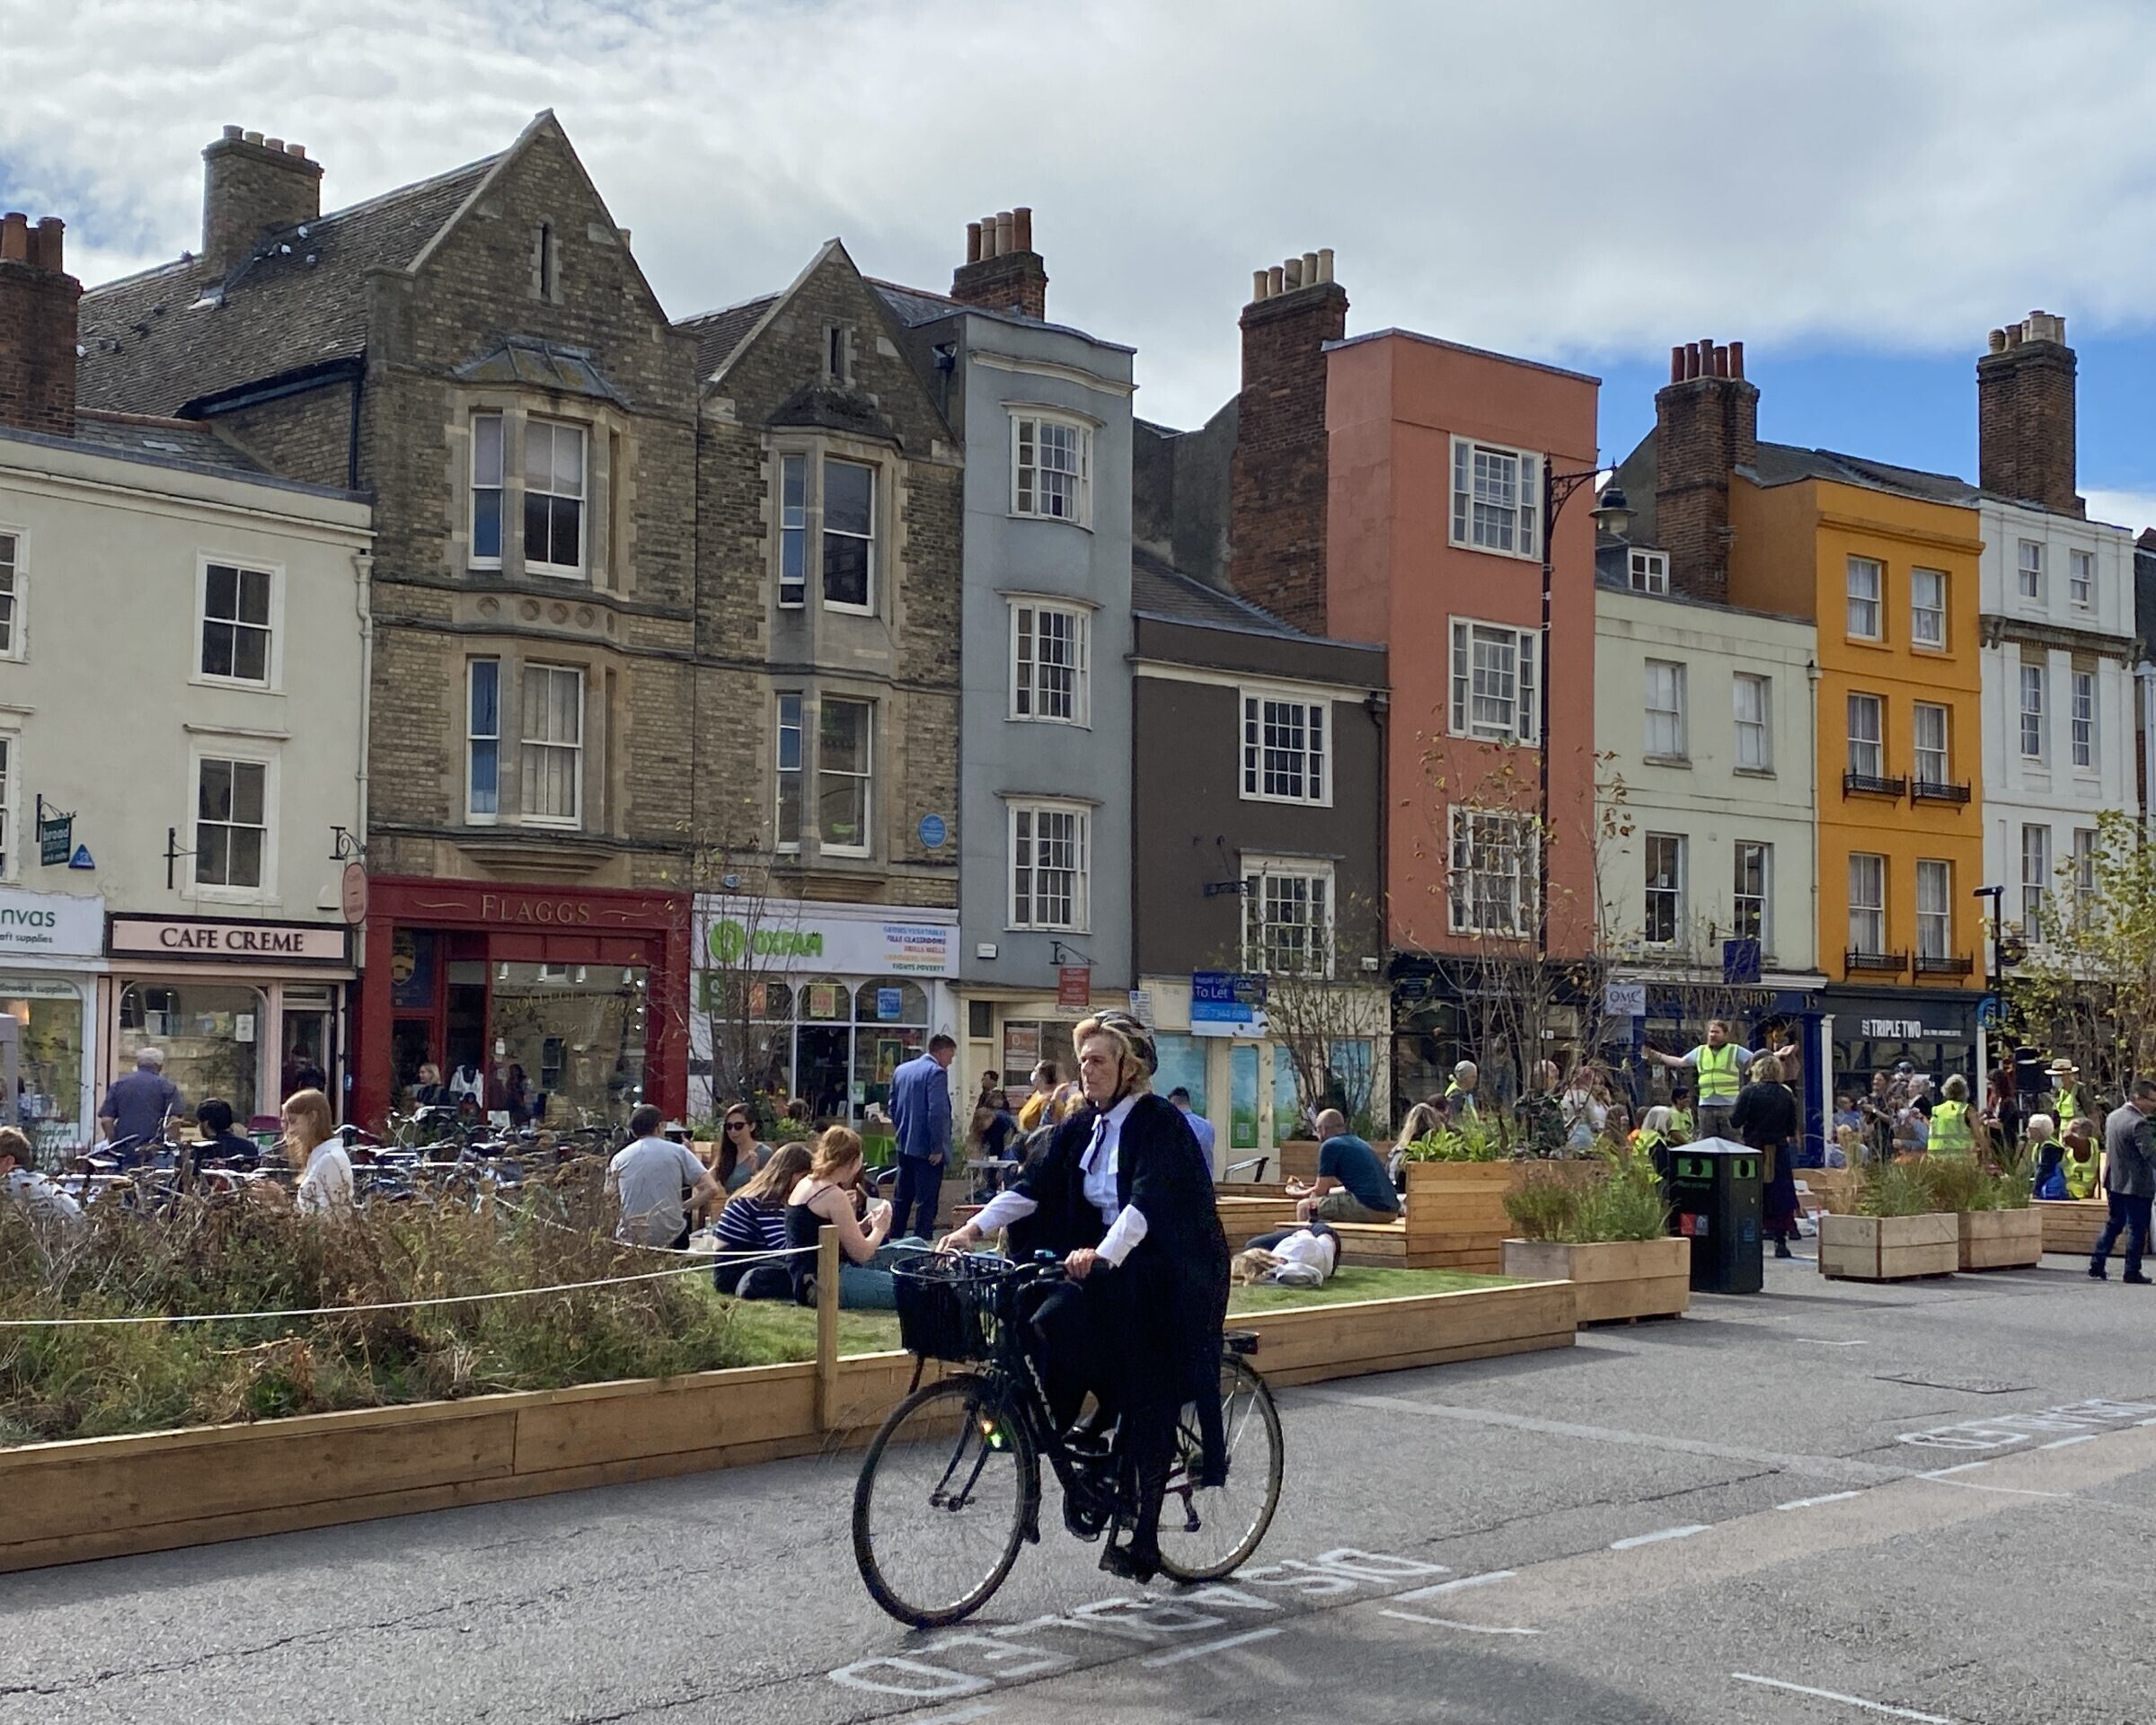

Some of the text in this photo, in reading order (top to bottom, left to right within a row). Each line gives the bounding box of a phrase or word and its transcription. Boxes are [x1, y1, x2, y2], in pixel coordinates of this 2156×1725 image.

[482, 894, 590, 924] FLAGGS
[16, 934, 53, 944] supplies
[159, 927, 304, 952] CAFE CREME
[752, 929, 823, 957] OXFAM
[1195, 986, 1228, 999] To Let
[1741, 991, 1777, 1007] SHOP
[1871, 1020, 1901, 1037] TRIPLE
[1902, 1021, 1922, 1038] TWO
